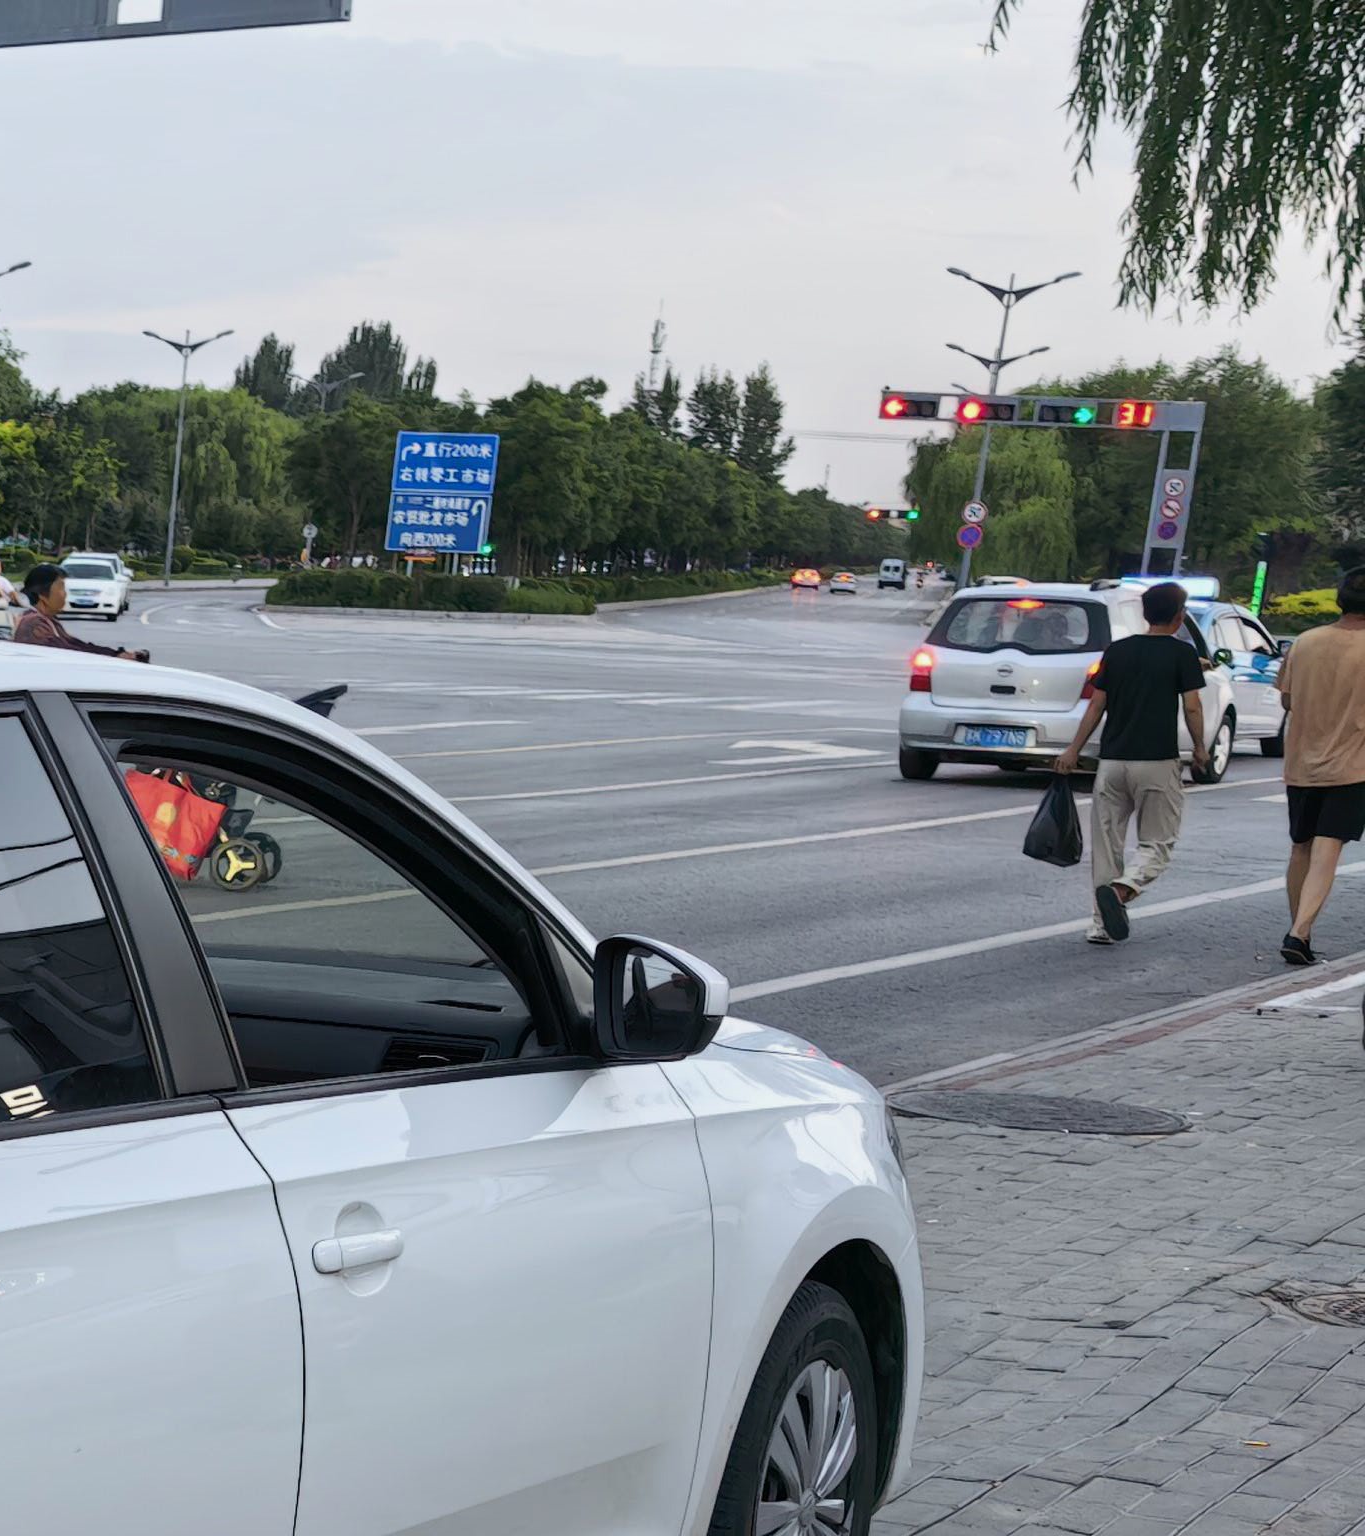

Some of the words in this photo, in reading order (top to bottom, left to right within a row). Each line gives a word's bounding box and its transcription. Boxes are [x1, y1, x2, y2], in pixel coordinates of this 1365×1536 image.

[1119, 402, 1153, 425] 31
[422, 442, 493, 459] 直行200米
